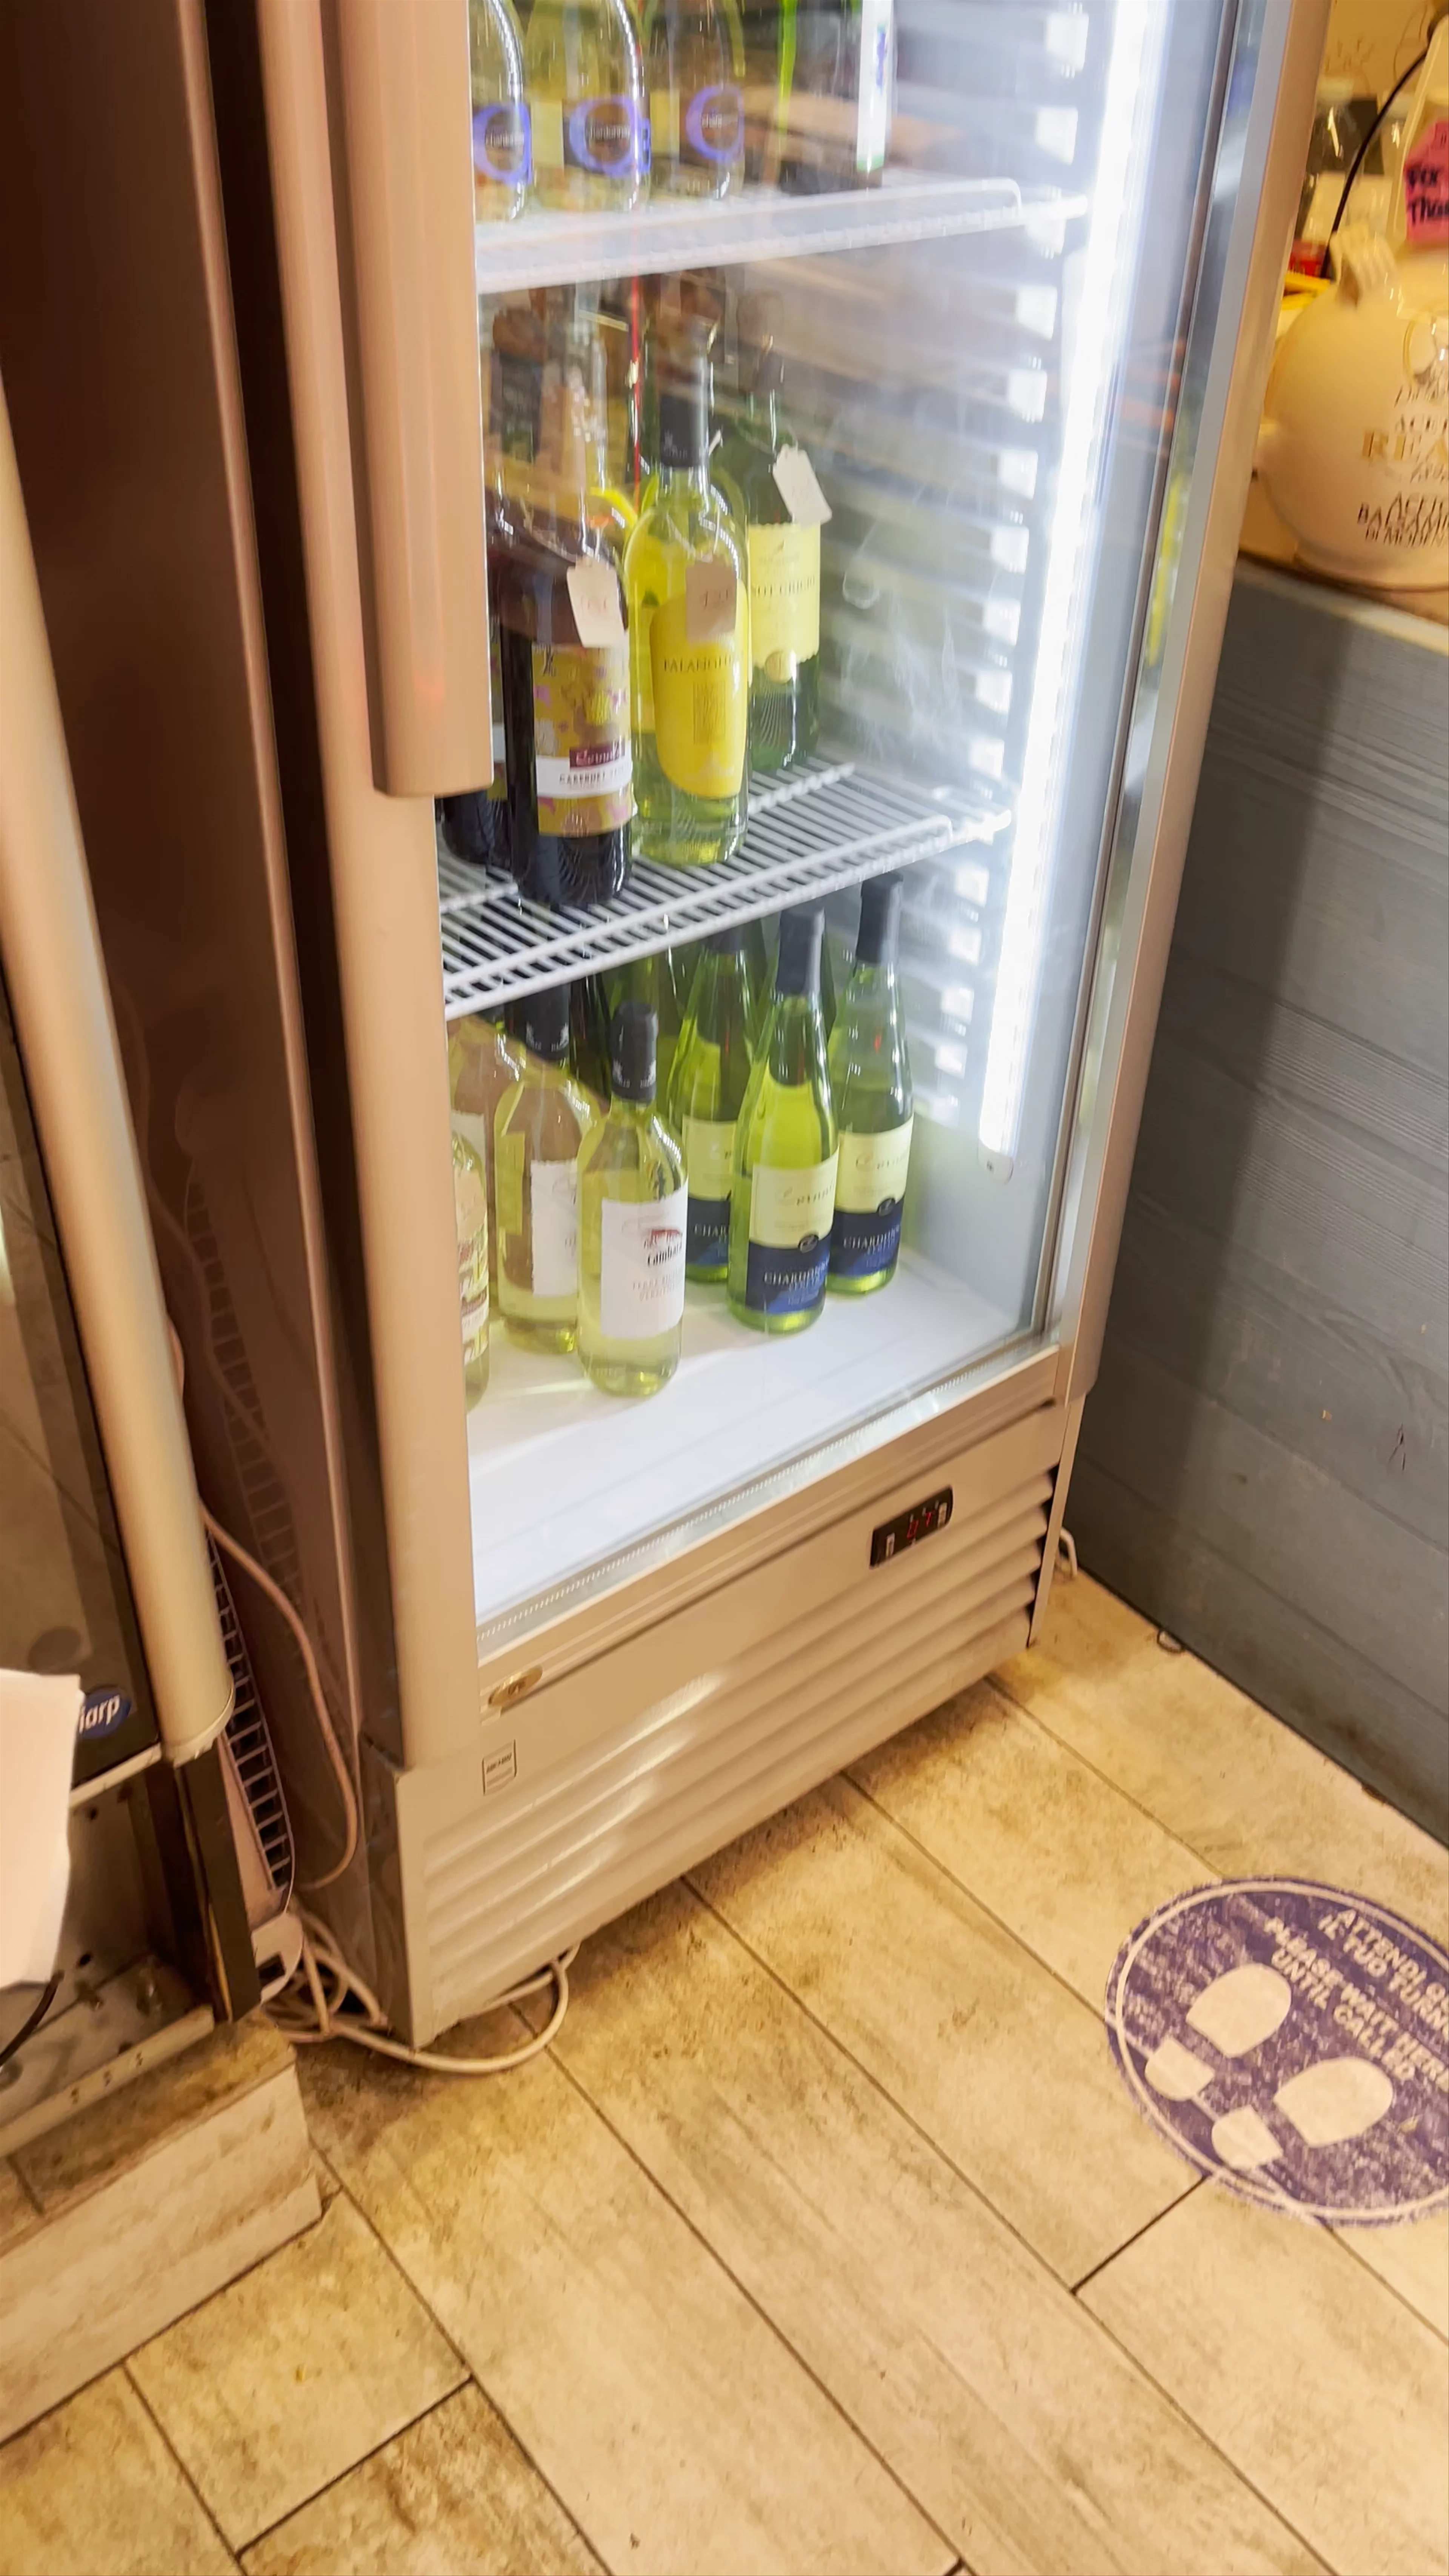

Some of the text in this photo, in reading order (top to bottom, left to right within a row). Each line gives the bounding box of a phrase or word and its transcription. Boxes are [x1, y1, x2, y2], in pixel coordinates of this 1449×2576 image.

[1263, 1915, 1344, 1988] PLEASE
[1340, 1982, 1400, 2036] WAIT
[1318, 1913, 1340, 1940] IL
[1343, 1933, 1389, 1978] TUO
[1337, 1909, 1427, 1987] ATTENDI
[1271, 1947, 1416, 2081] UNTIL CALLED
